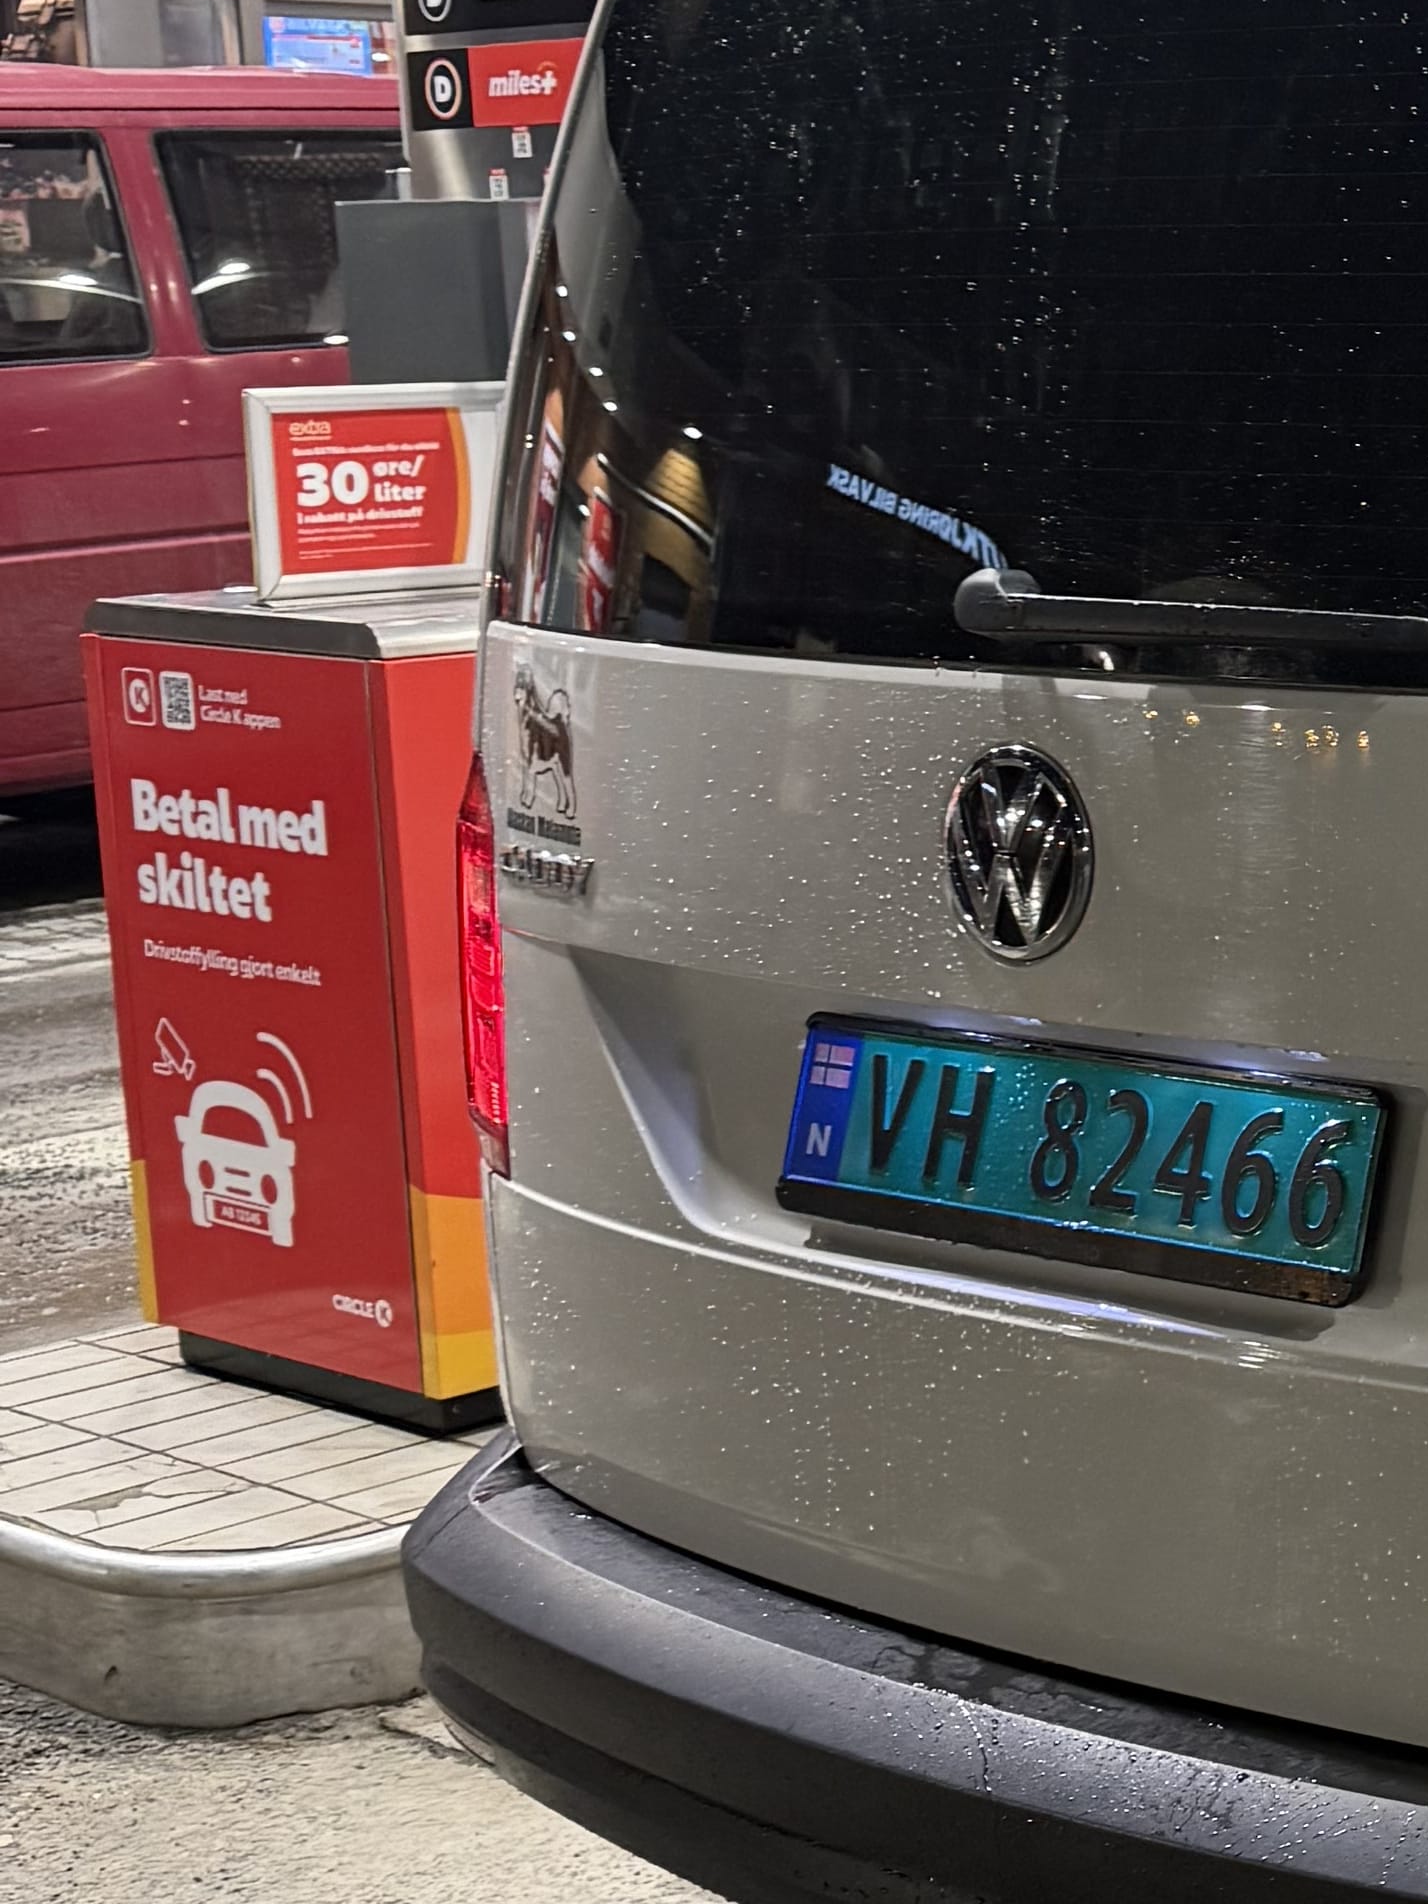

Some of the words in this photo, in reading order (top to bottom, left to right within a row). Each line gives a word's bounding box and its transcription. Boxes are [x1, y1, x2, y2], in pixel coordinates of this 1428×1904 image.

[434, 75, 451, 102] D
[296, 461, 369, 507] 30
[374, 481, 426, 503] liter
[131, 778, 236, 843] Betal
[238, 799, 329, 856] med
[138, 851, 273, 923] skiltet
[805, 1124, 831, 1158] N
[869, 1052, 994, 1190] VH
[1029, 1077, 1352, 1249] 82466
